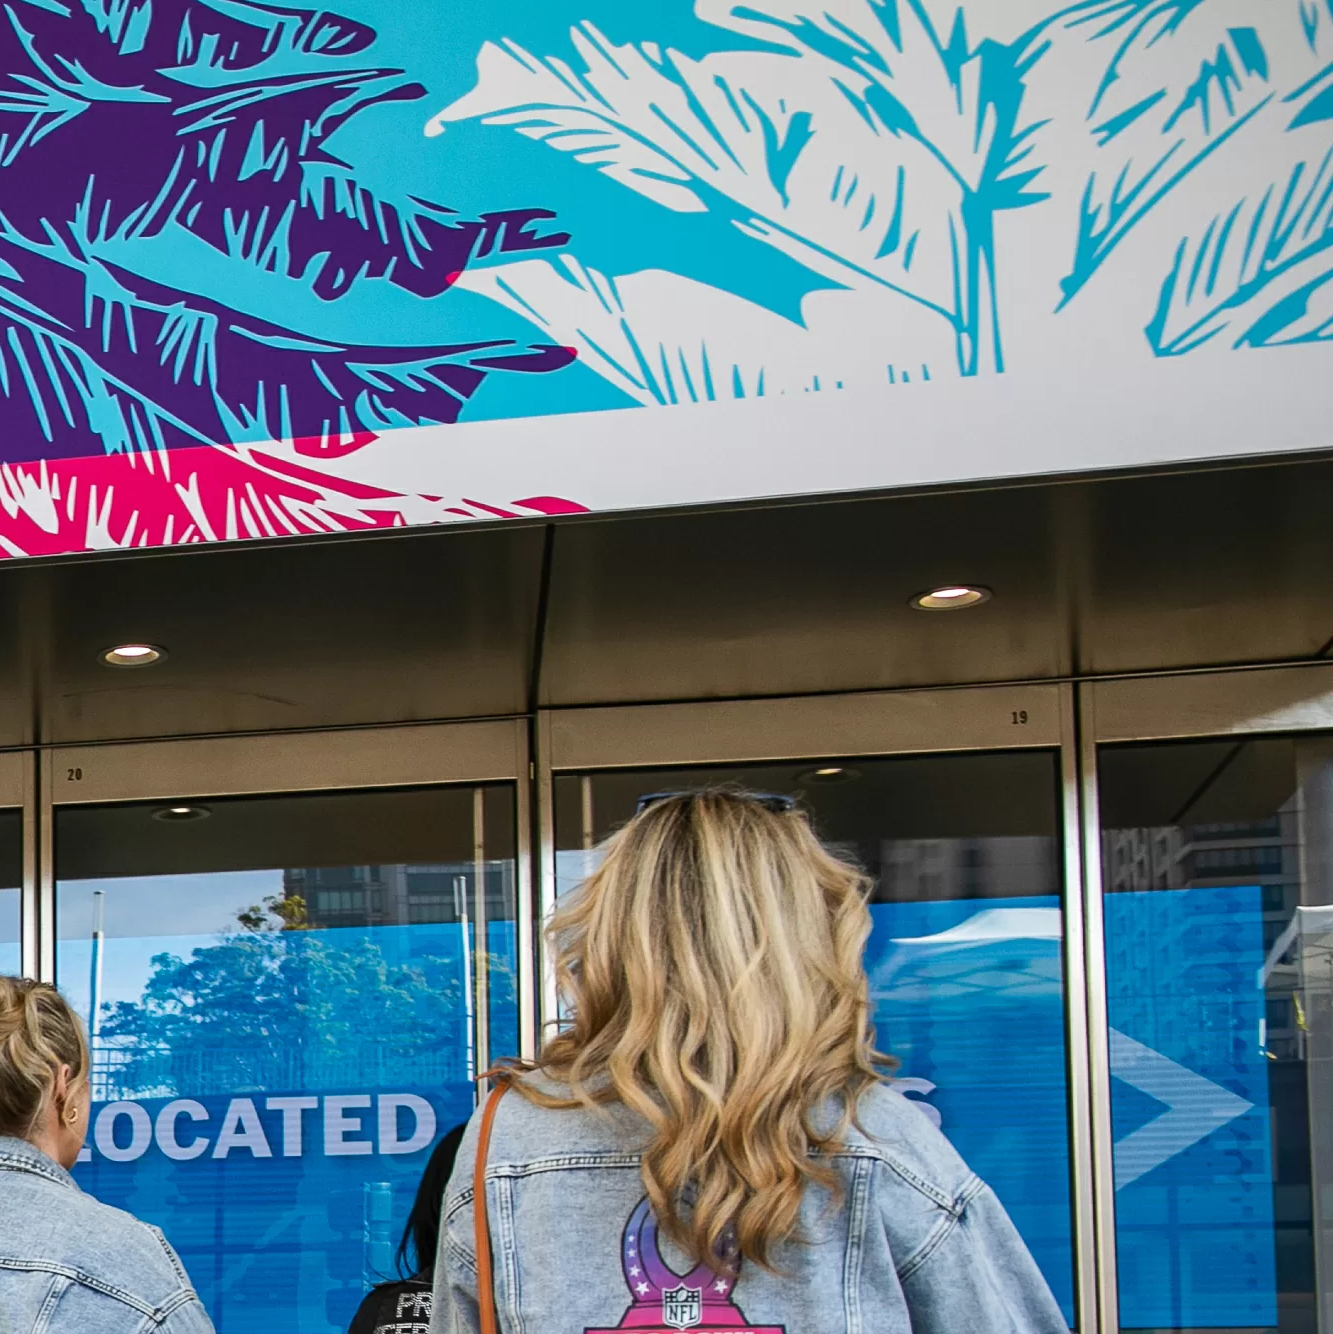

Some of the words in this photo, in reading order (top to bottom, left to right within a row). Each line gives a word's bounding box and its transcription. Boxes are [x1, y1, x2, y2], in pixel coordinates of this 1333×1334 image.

[1011, 710, 1027, 724] 19
[67, 768, 82, 781] 20
[396, 1291, 433, 1318] PR
[669, 1304, 697, 1322] NFL
